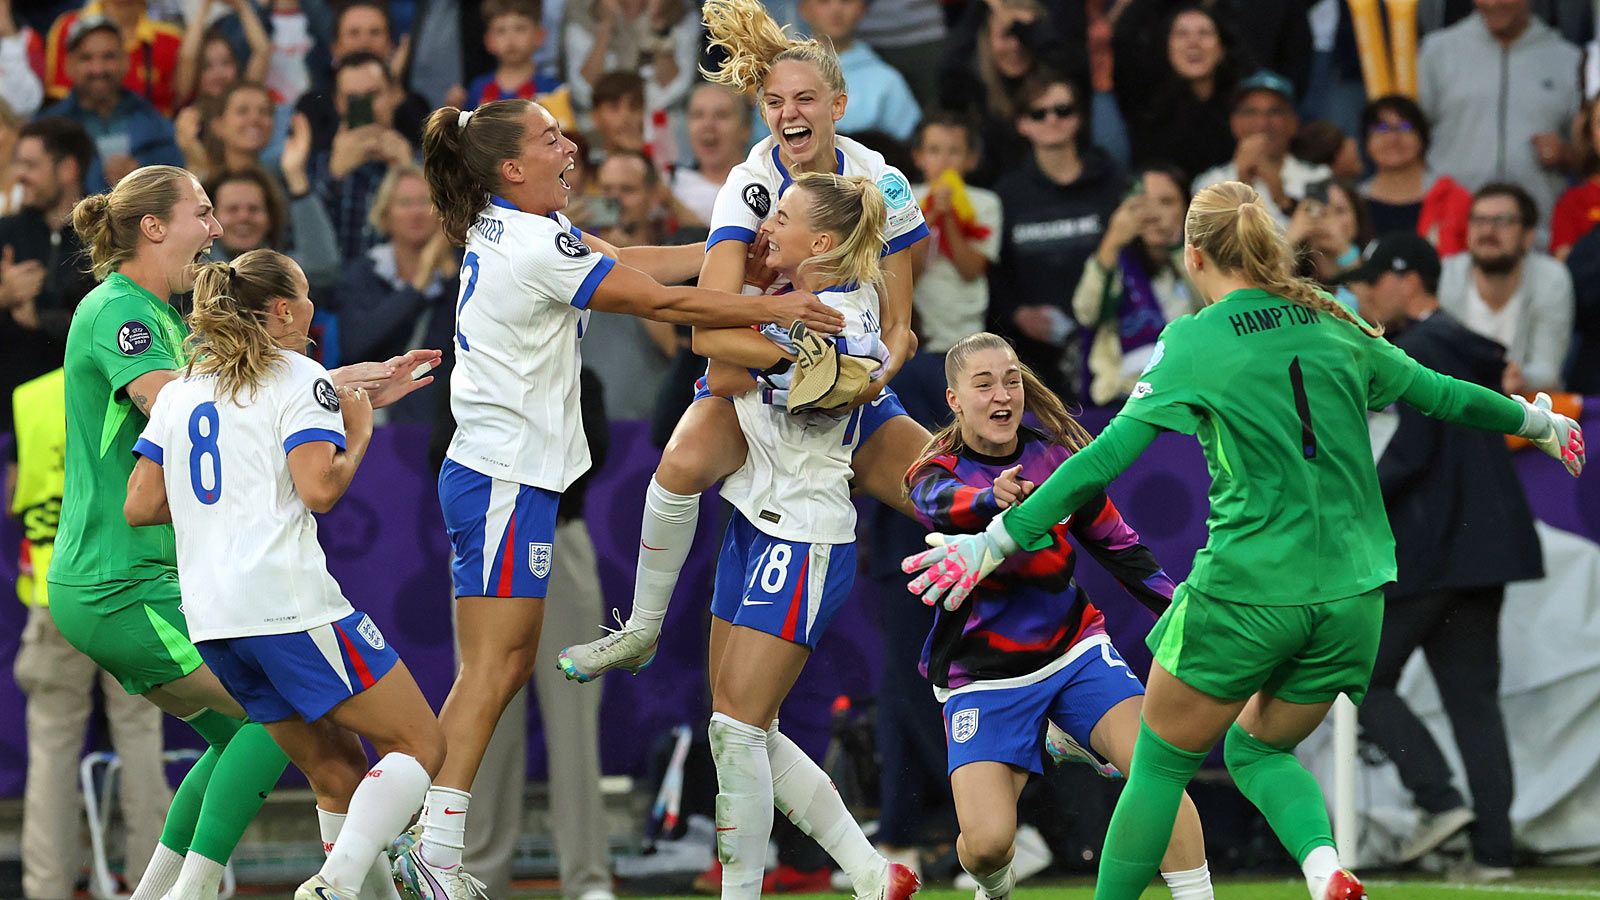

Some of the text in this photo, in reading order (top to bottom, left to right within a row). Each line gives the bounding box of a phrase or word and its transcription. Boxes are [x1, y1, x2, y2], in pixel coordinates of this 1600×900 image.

[1229, 304, 1321, 337] HAMPTON
[1288, 356, 1316, 460] 1
[188, 402, 221, 505] 8
[748, 543, 793, 594] 18
[365, 769, 383, 778] NG
